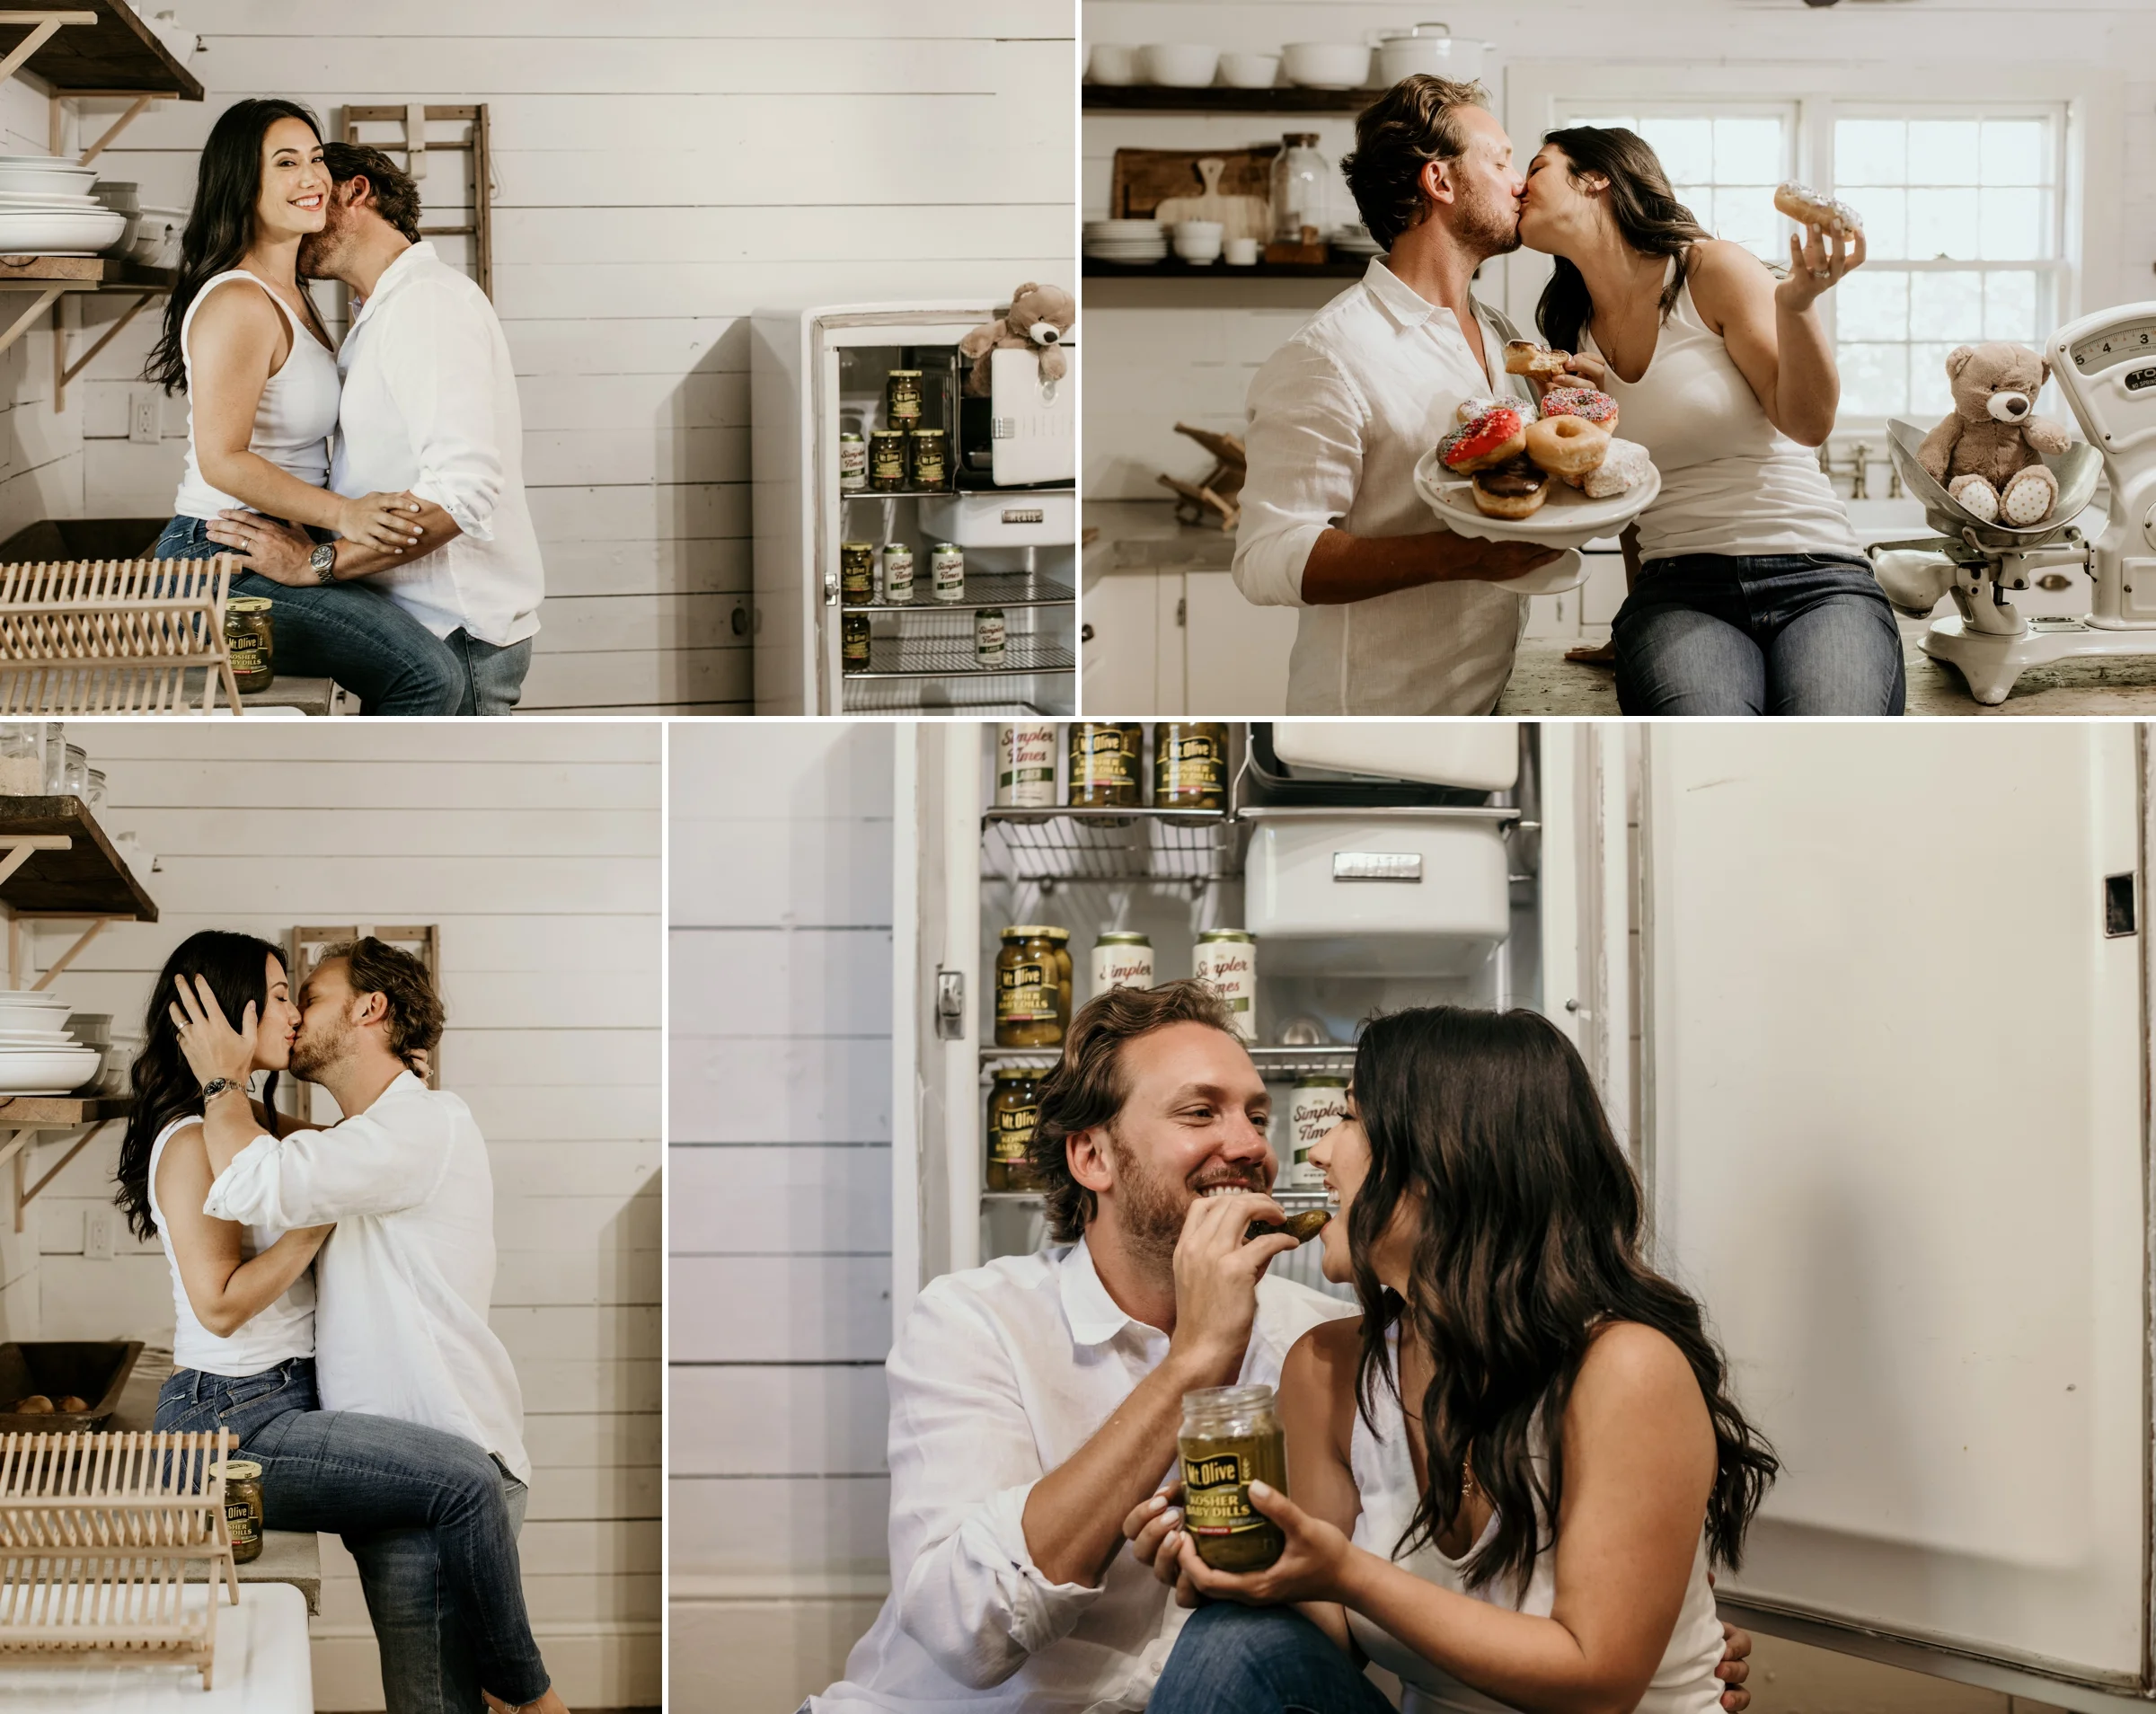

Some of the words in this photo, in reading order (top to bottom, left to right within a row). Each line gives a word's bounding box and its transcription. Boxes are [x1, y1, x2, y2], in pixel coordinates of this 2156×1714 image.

[2074, 354, 2085, 366] 5
[2103, 342, 2111, 352] 4
[2140, 334, 2149, 344] 3
[841, 449, 865, 459] Simple
[238, 637, 257, 649] Olive
[1014, 967, 1040, 985] Olive
[1294, 1100, 1345, 1123] Simpler
[1015, 1110, 1038, 1129] Oliv
[1299, 1123, 1331, 1141] Tim
[1201, 1461, 1236, 1486] Olive
[1189, 1495, 1240, 1506] KOSHER
[228, 1506, 247, 1519] Olive
[1212, 1504, 1250, 1517] DILLS
[232, 1528, 252, 1536] DILLS
